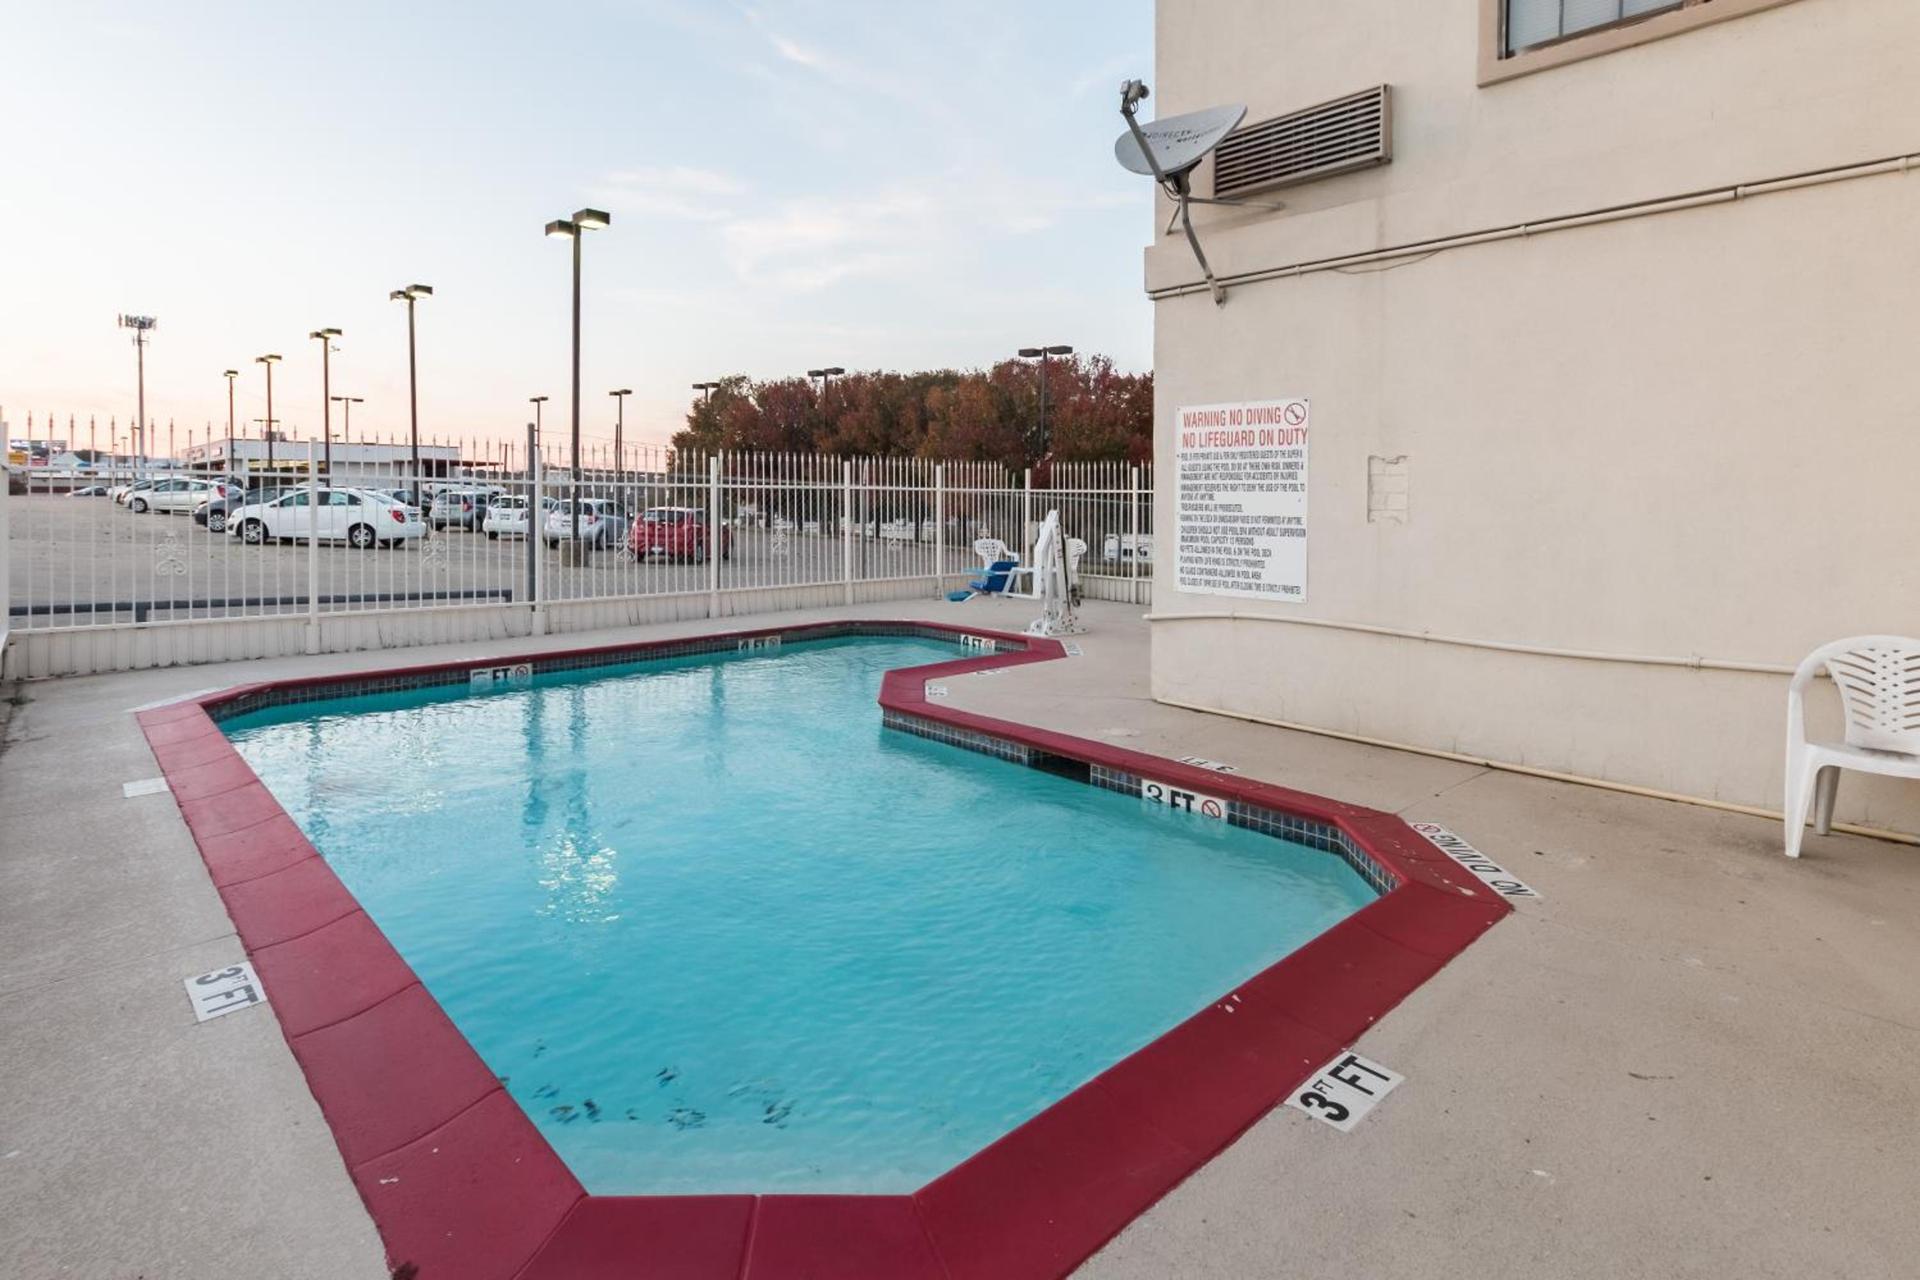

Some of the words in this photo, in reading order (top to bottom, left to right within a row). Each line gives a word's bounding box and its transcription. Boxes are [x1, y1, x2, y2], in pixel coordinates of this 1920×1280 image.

[1183, 410, 1226, 428] WARNING
[1229, 408, 1243, 425] NO
[1246, 407, 1281, 425] DIVING
[1182, 432, 1196, 449] NO
[1199, 430, 1255, 448] LIFEGUARD
[1259, 429, 1274, 447] ON
[1278, 428, 1308, 446] DUTY
[1170, 790, 1195, 813] FT
[1429, 835, 1502, 872] DIVING
[1491, 881, 1535, 896] NO
[202, 984, 259, 1013] FT
[1328, 1055, 1390, 1096] FT
[1300, 1092, 1349, 1121] 3
